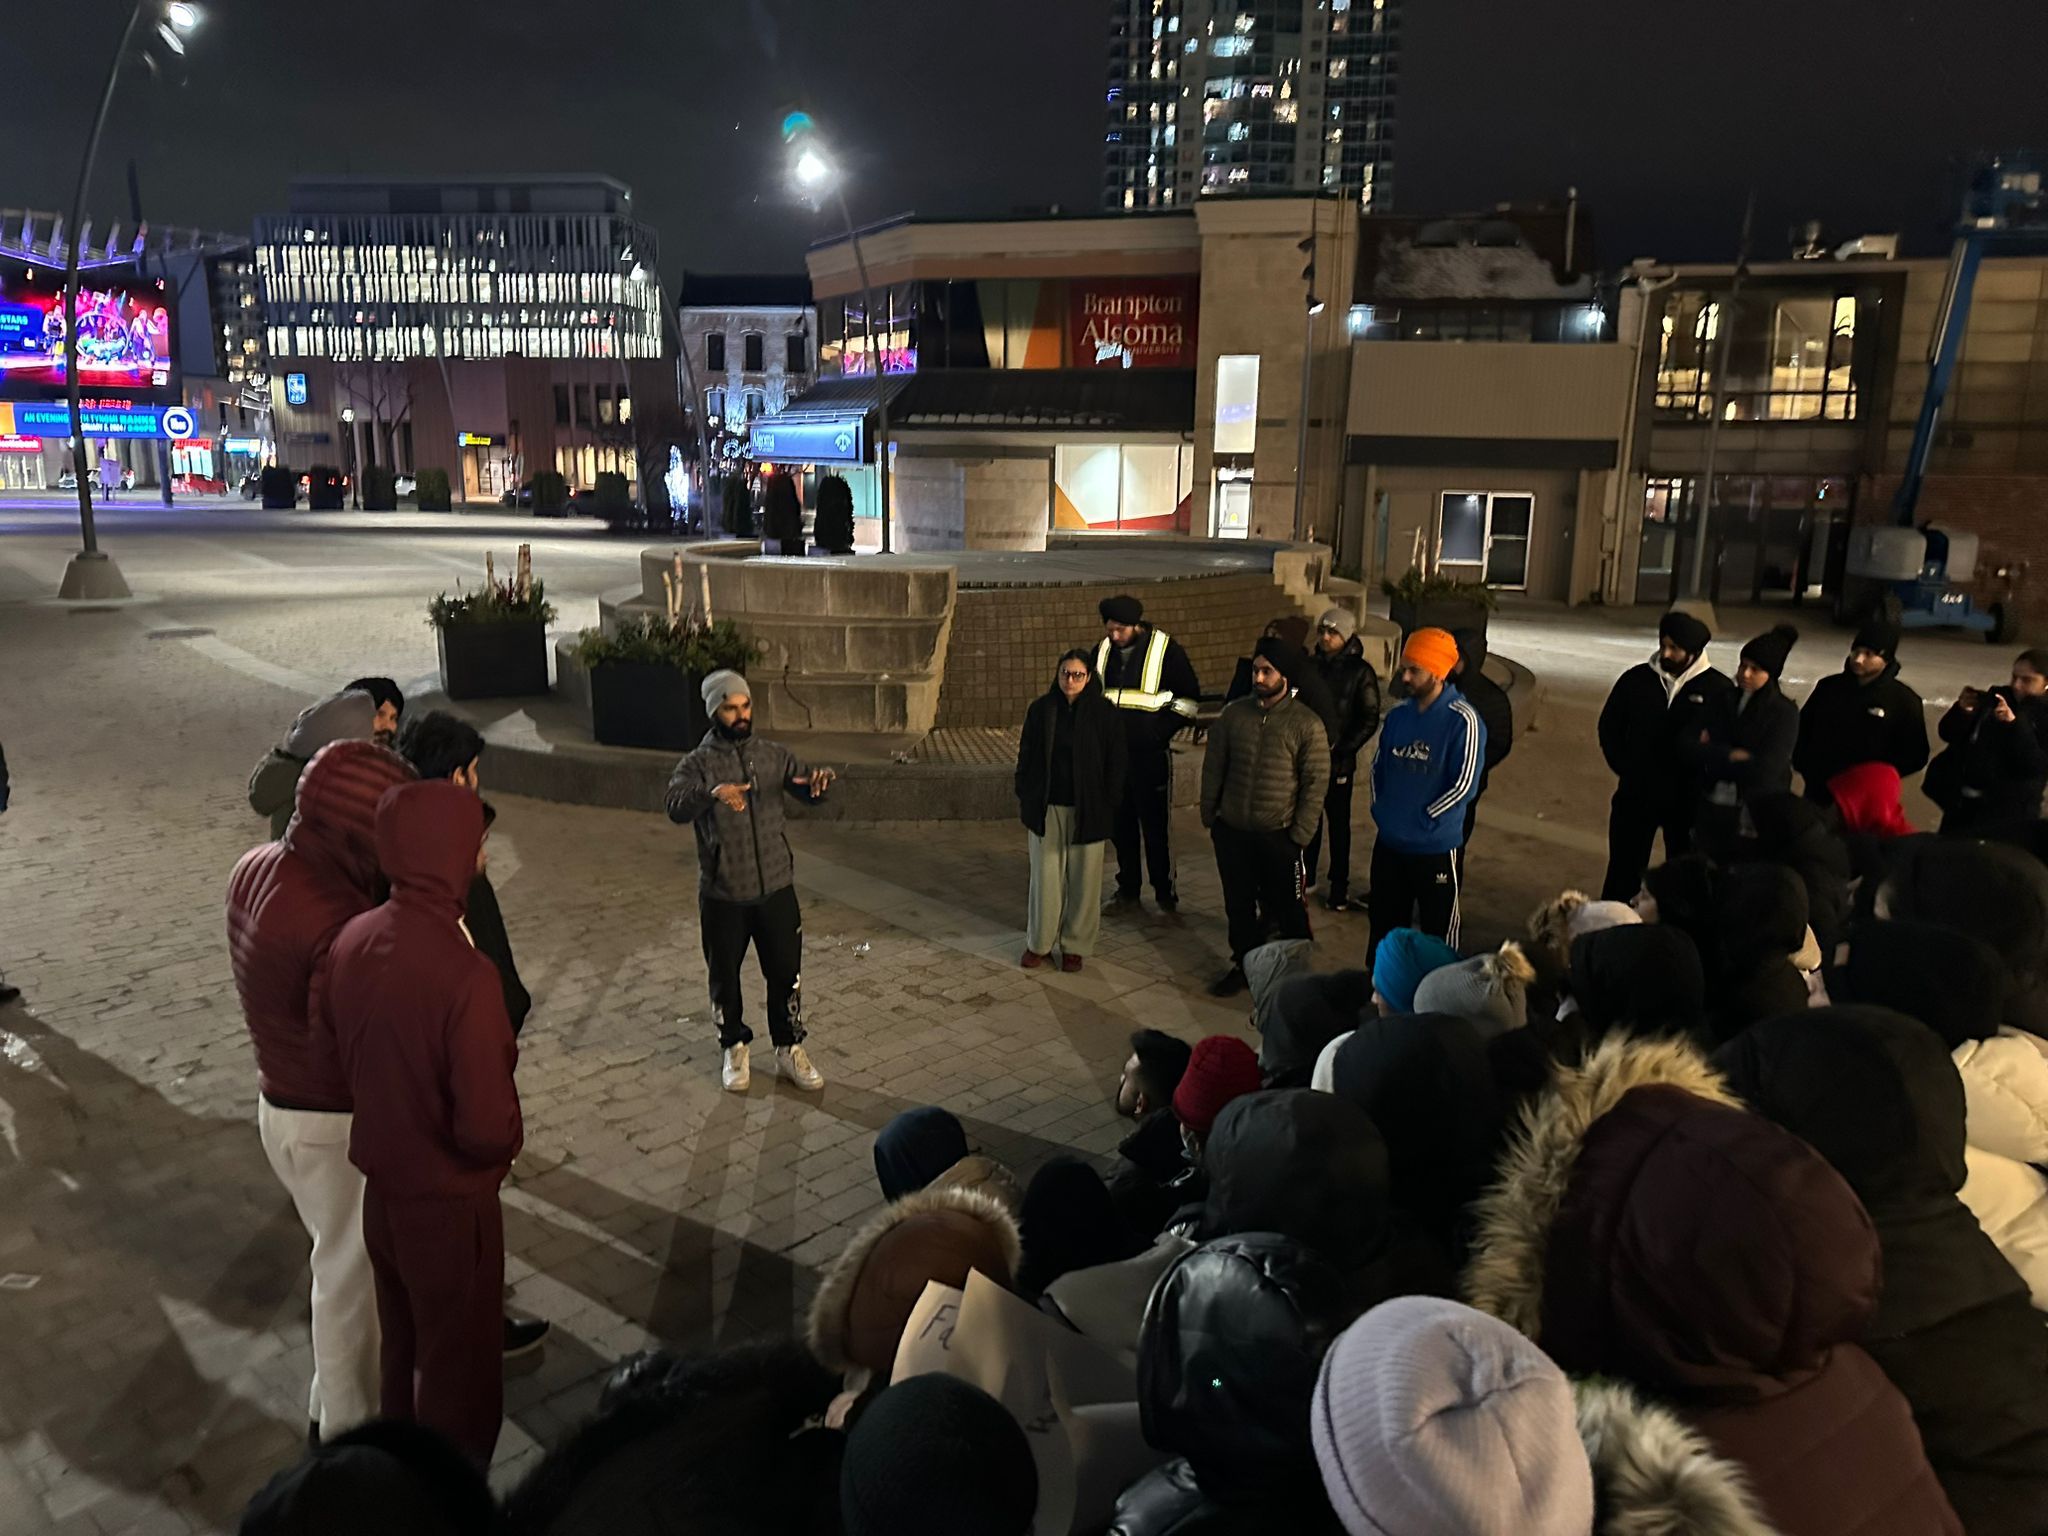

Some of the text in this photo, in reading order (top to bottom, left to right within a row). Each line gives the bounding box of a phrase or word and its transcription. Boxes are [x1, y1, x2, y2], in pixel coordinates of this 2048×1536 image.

[1084, 293, 1181, 320] Brampton
[1080, 318, 1182, 345] Algoma
[1941, 593, 1964, 603] 4x4
[919, 1304, 958, 1351] Fa
